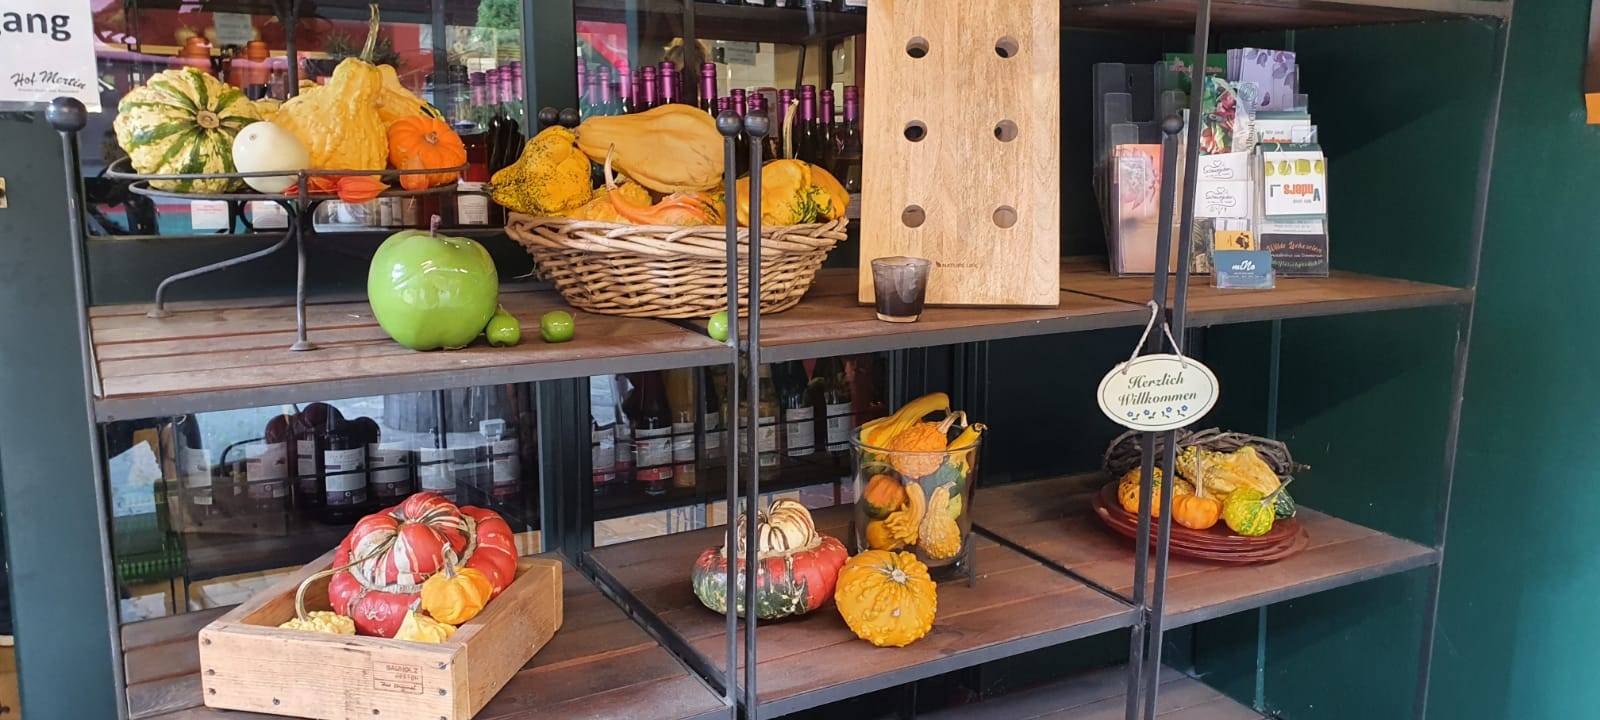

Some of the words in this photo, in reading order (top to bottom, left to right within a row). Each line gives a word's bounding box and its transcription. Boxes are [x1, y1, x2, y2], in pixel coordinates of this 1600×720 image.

[0, 11, 72, 42] ang
[10, 71, 36, 87] Hof
[1127, 371, 1184, 389] Herzlich
[1118, 391, 1197, 406] Willkommen
